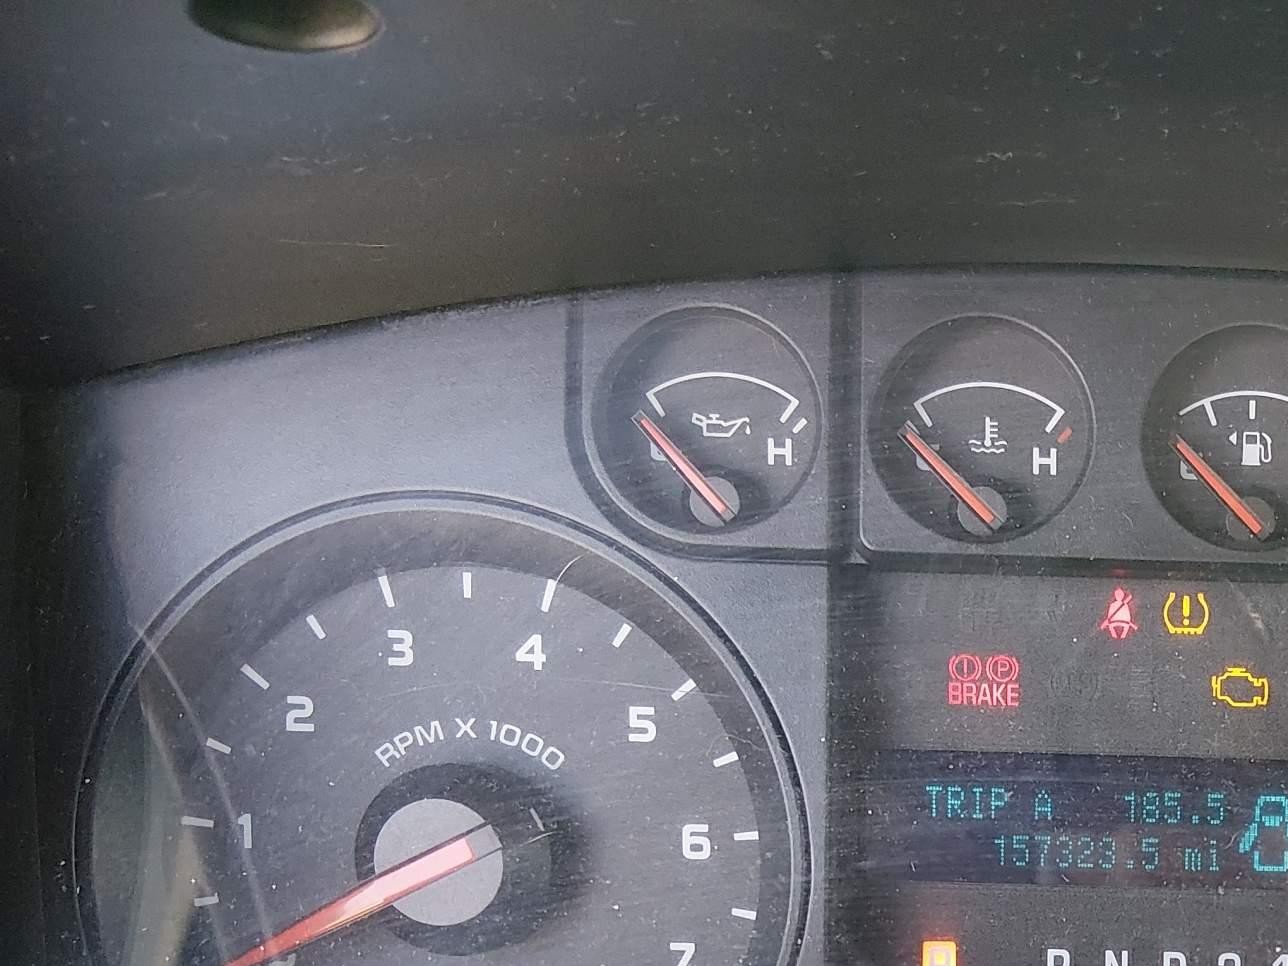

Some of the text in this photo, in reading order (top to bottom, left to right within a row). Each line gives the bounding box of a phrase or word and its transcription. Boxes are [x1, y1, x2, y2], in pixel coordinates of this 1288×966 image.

[768, 438, 792, 465] H
[1033, 447, 1057, 475] H
[388, 630, 413, 666] 3
[516, 634, 546, 670] 4
[948, 682, 1020, 706] BRAKE
[286, 696, 314, 731] 2
[629, 706, 656, 742] 5
[374, 717, 565, 770] RPM X 1000
[926, 785, 1225, 825] TRIP A 185.5
[238, 814, 252, 848] 1
[682, 824, 710, 859] 6
[1184, 840, 1220, 872] mi
